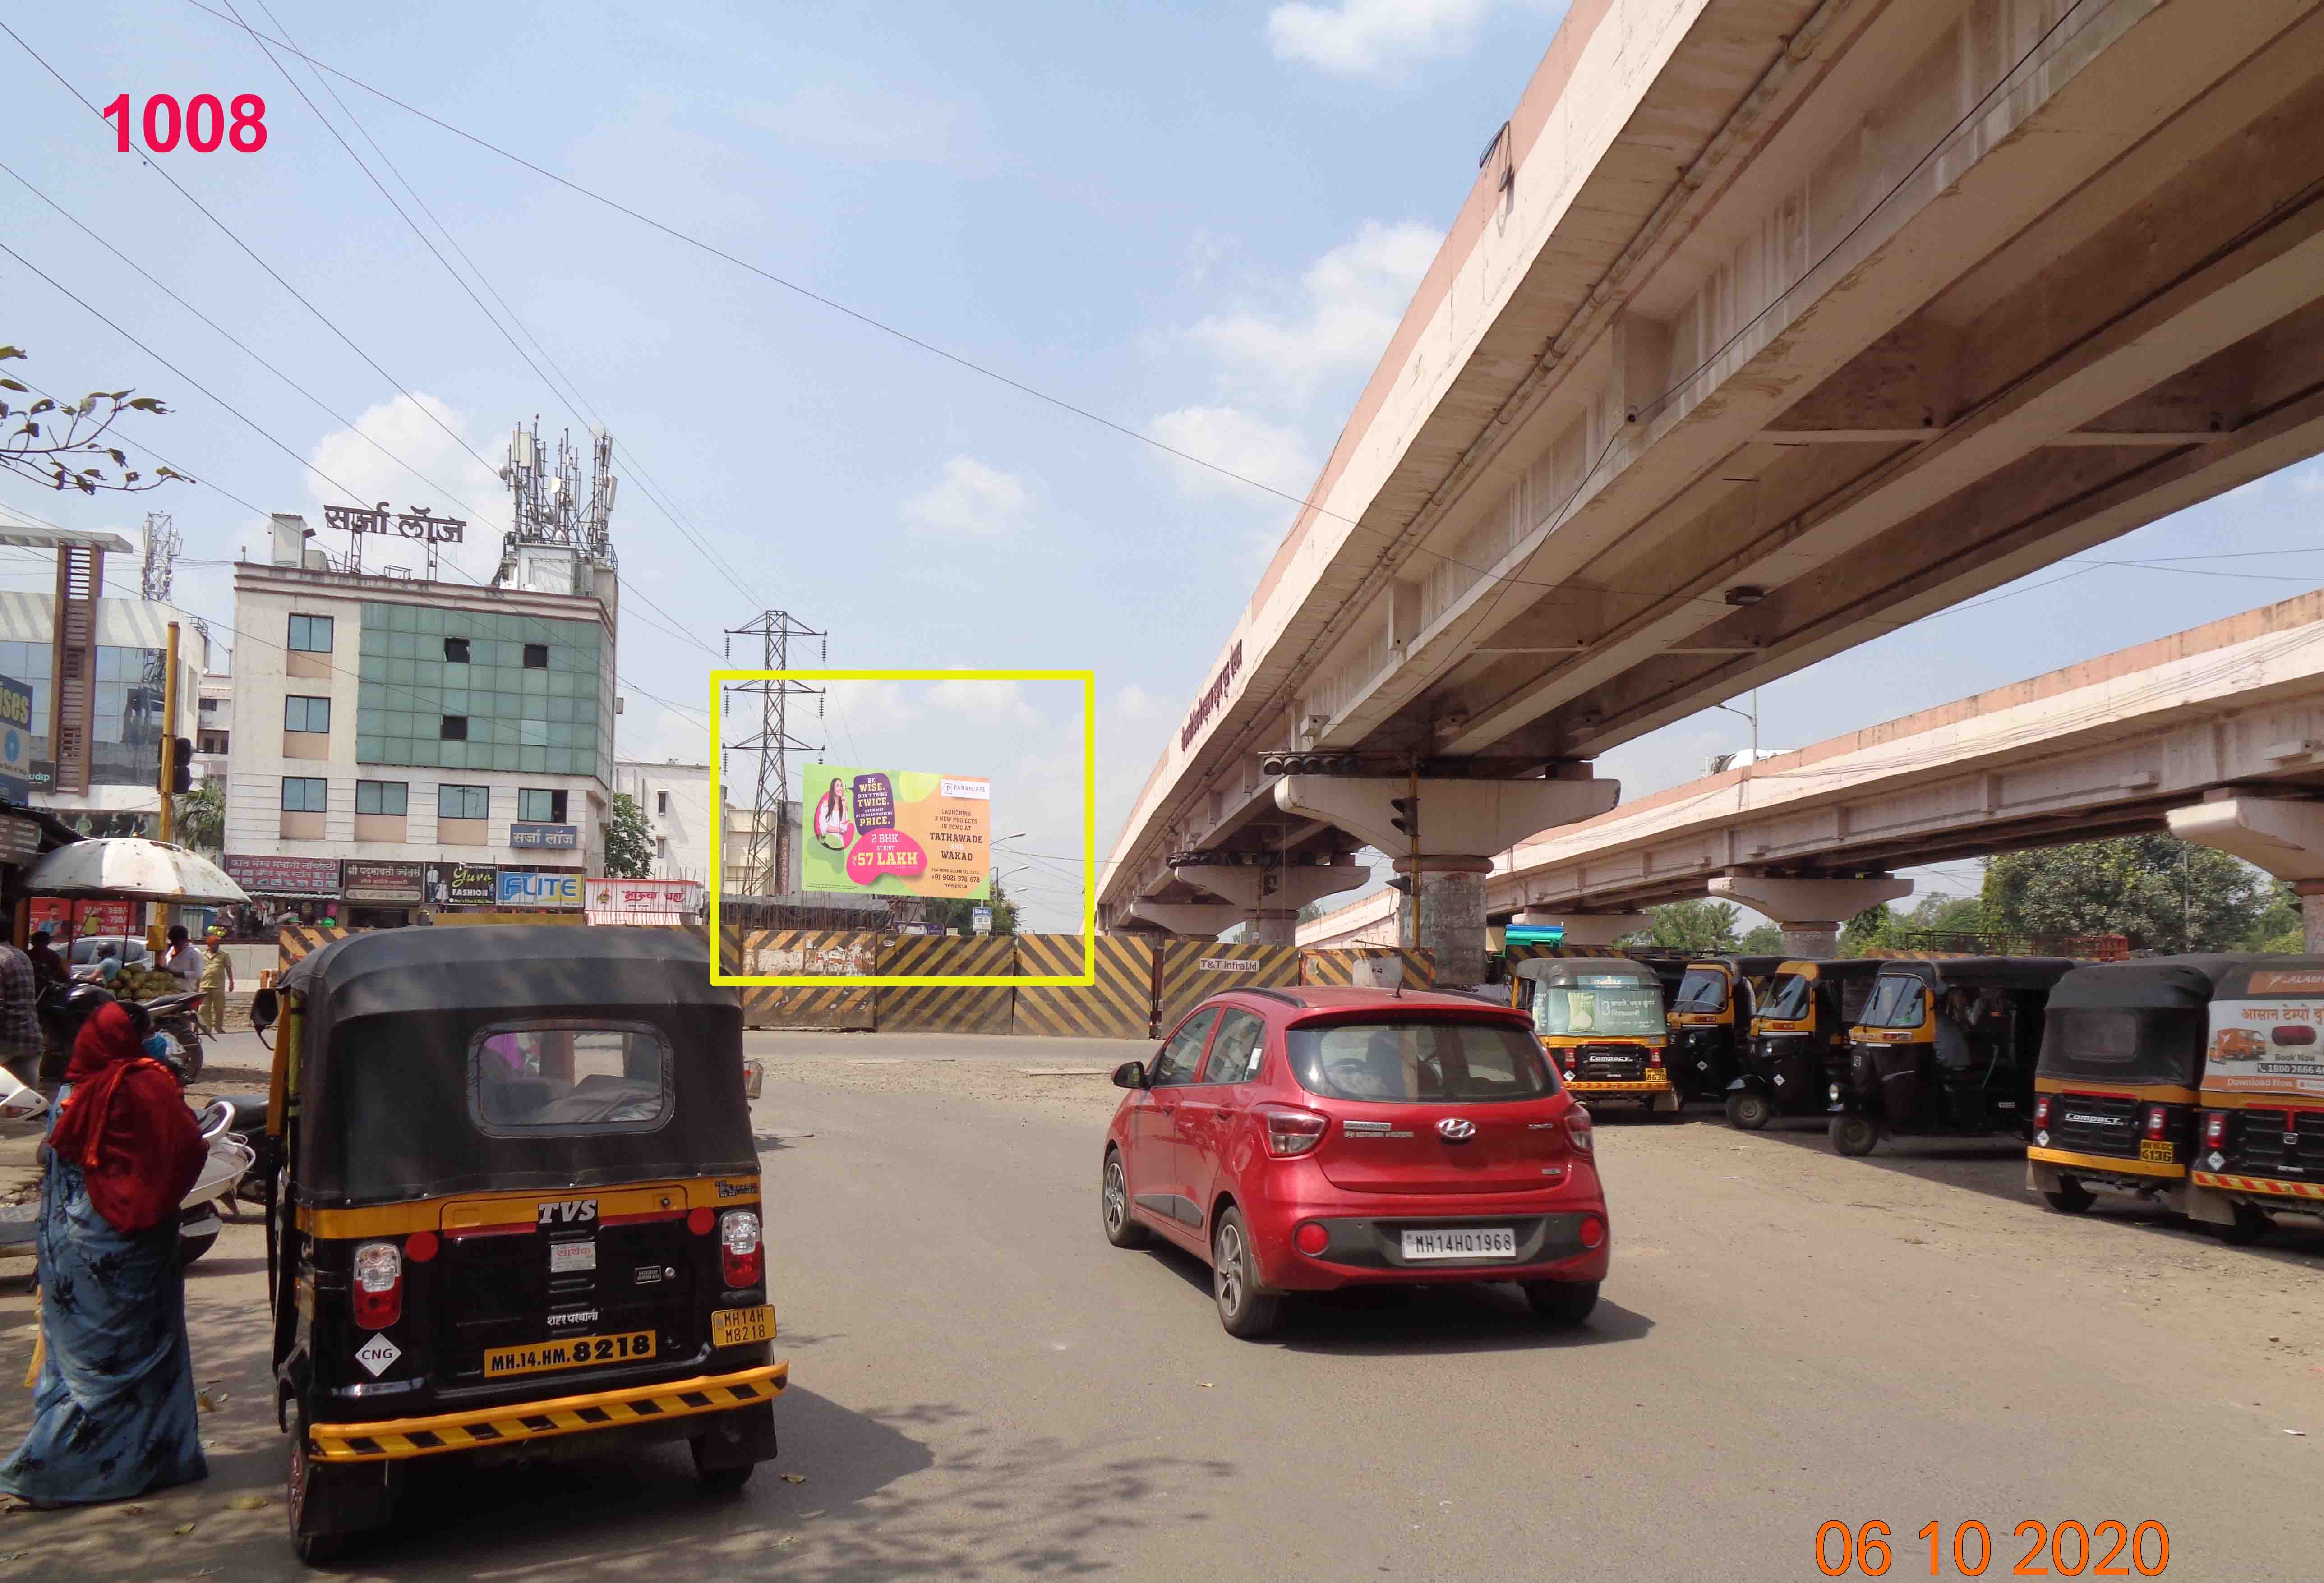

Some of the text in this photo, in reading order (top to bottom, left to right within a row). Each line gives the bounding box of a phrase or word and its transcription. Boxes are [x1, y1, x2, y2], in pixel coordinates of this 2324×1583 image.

[323, 501, 467, 543] सर्जा लॉज
[859, 783, 885, 792] WISE.
[954, 784, 986, 793] PARANJAPE
[858, 797, 890, 807] TWICE.
[859, 816, 890, 827] PRICE.
[512, 829, 574, 845] सर्जा लॉज
[872, 833, 899, 843] 2 BHK
[930, 833, 982, 843] TATHAWADE
[876, 851, 918, 865] LAKH
[941, 851, 973, 861] WAKAD
[347, 864, 358, 875] श्री
[505, 877, 578, 897] FLITE
[1201, 959, 1223, 969] T&T
[2241, 1008, 2278, 1021] आसान
[2268, 1065, 2290, 1073] 1800
[2227, 1078, 2270, 1086] Download
[539, 1200, 598, 1224] TVS
[725, 1308, 764, 1326] MH14H
[725, 1324, 765, 1343] M8218
[362, 1349, 392, 1359] CNG
